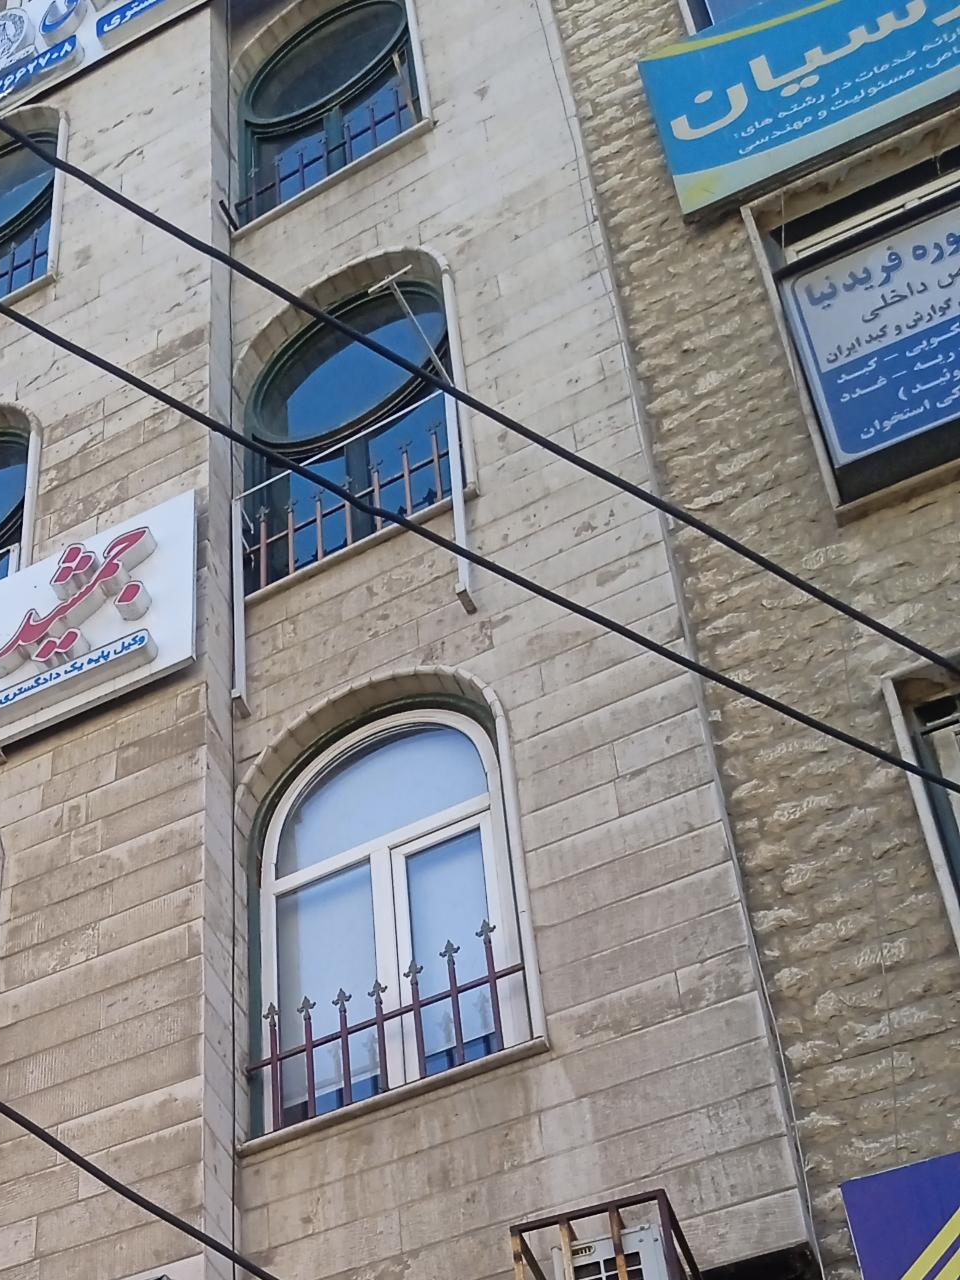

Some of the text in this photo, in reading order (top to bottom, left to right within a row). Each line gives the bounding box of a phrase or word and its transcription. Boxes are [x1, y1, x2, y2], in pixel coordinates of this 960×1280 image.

[777, 49, 917, 119] خدمات در رشته
[738, 67, 916, 156] مسئولیت مهندسی
[805, 245, 904, 310] فریدنیا
[861, 278, 928, 324] داخلی
[825, 296, 952, 364] گوارش کبد ایران
[836, 356, 878, 384] کبد
[840, 375, 888, 402] غدد
[860, 397, 931, 441] استخوان
[87, 651, 111, 667] پایه
[113, 633, 147, 659] وکیل
